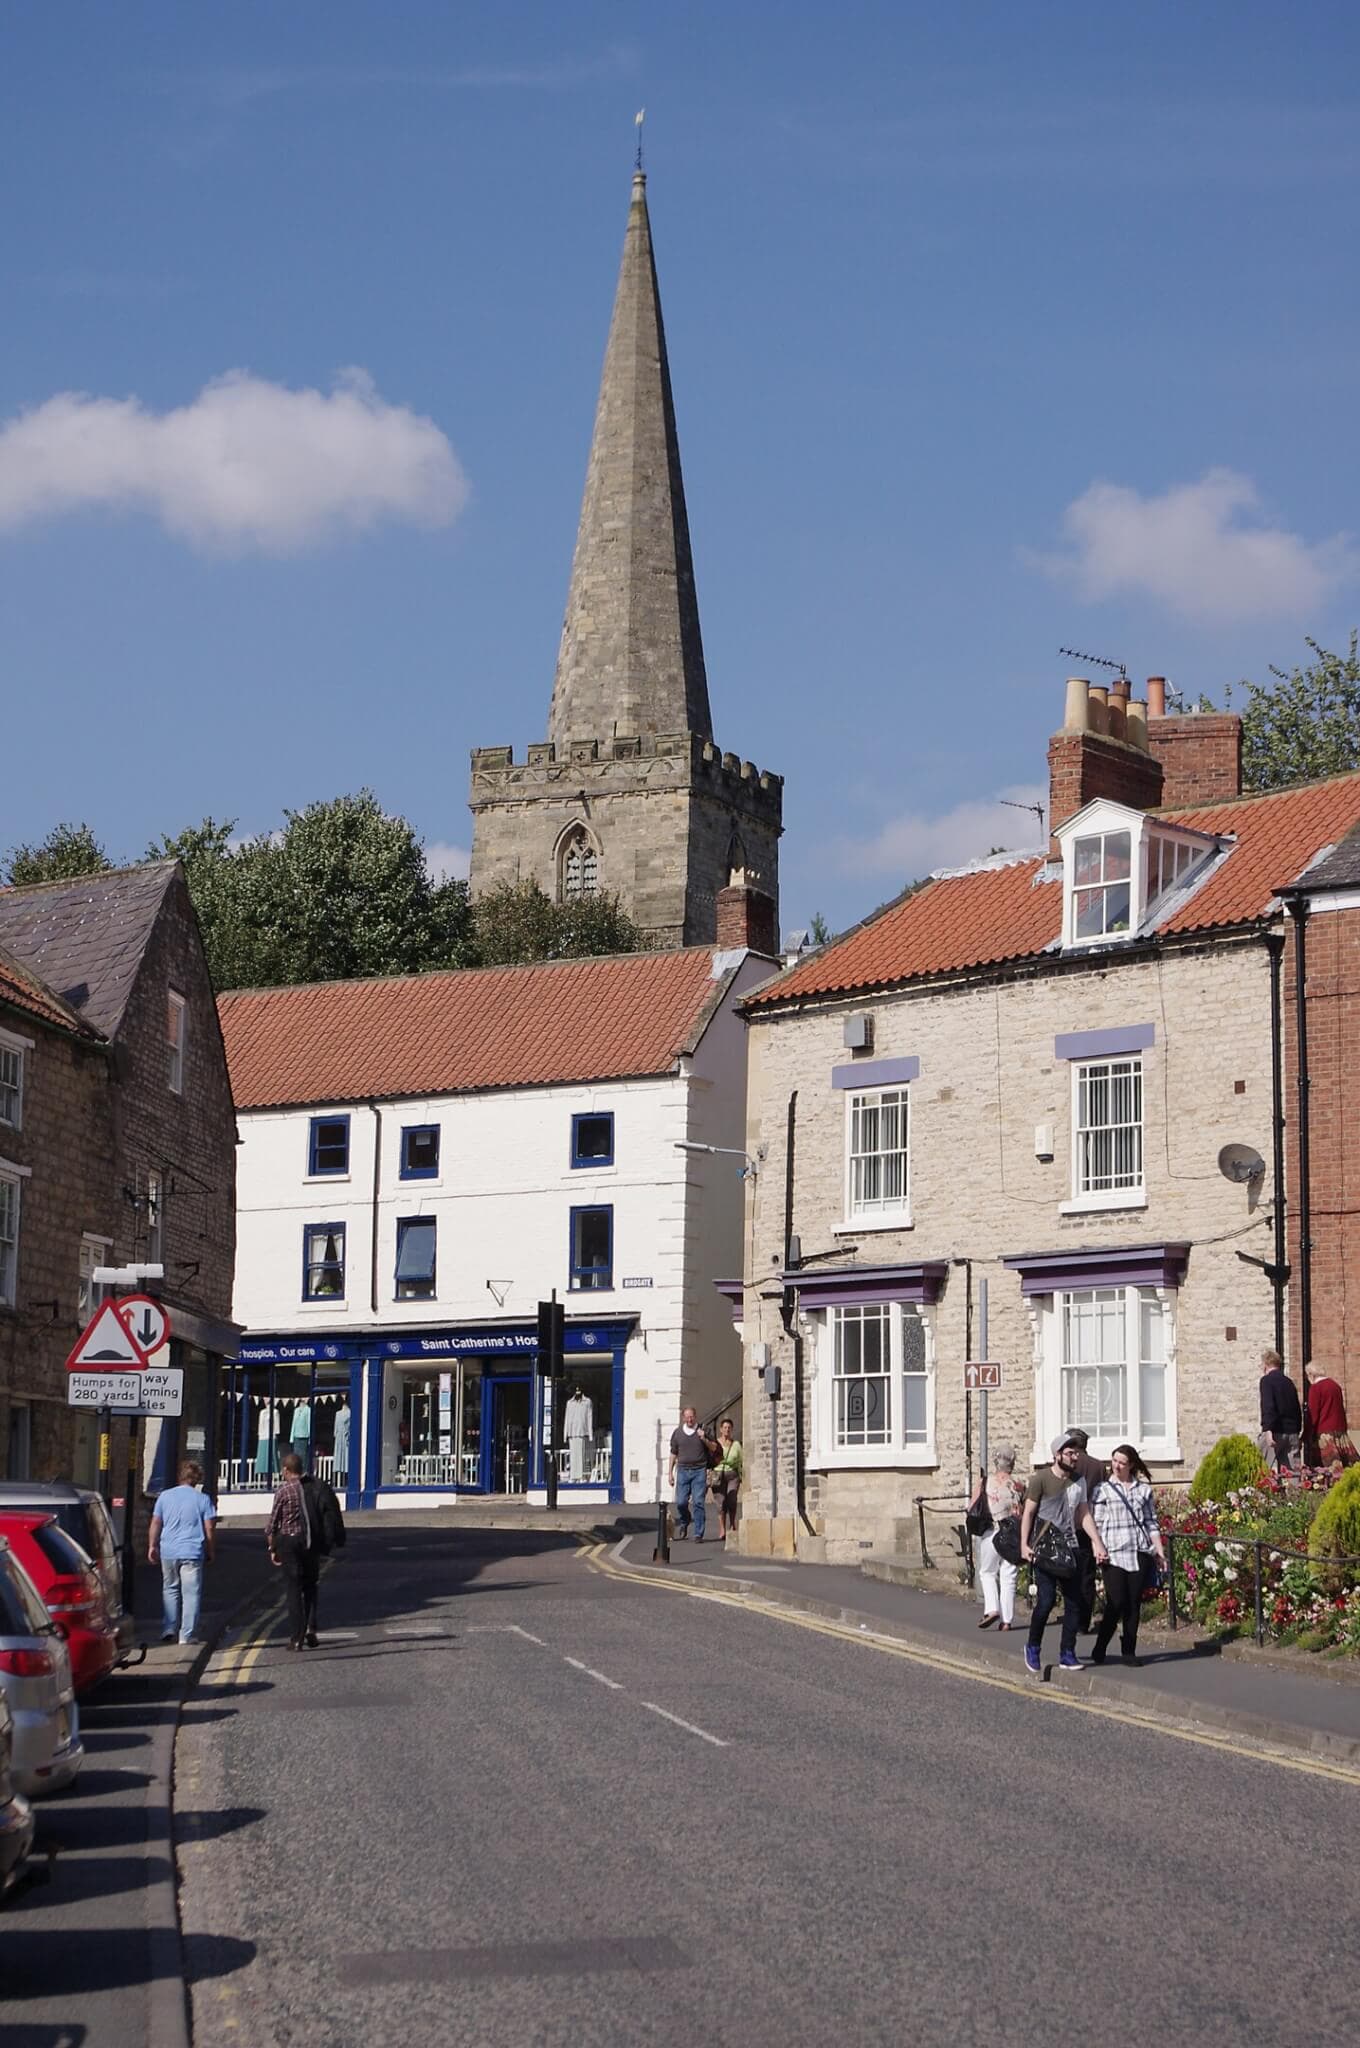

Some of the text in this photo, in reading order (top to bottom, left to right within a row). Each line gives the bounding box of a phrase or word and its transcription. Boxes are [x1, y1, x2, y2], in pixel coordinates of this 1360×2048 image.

[420, 1339, 450, 1350] Saint
[451, 1336, 514, 1349] Catherine's
[280, 1347, 296, 1357] Our
[297, 1347, 316, 1356] care
[72, 1377, 136, 1388] Humps for
[144, 1375, 169, 1385] way
[74, 1389, 135, 1402] 280 yards
